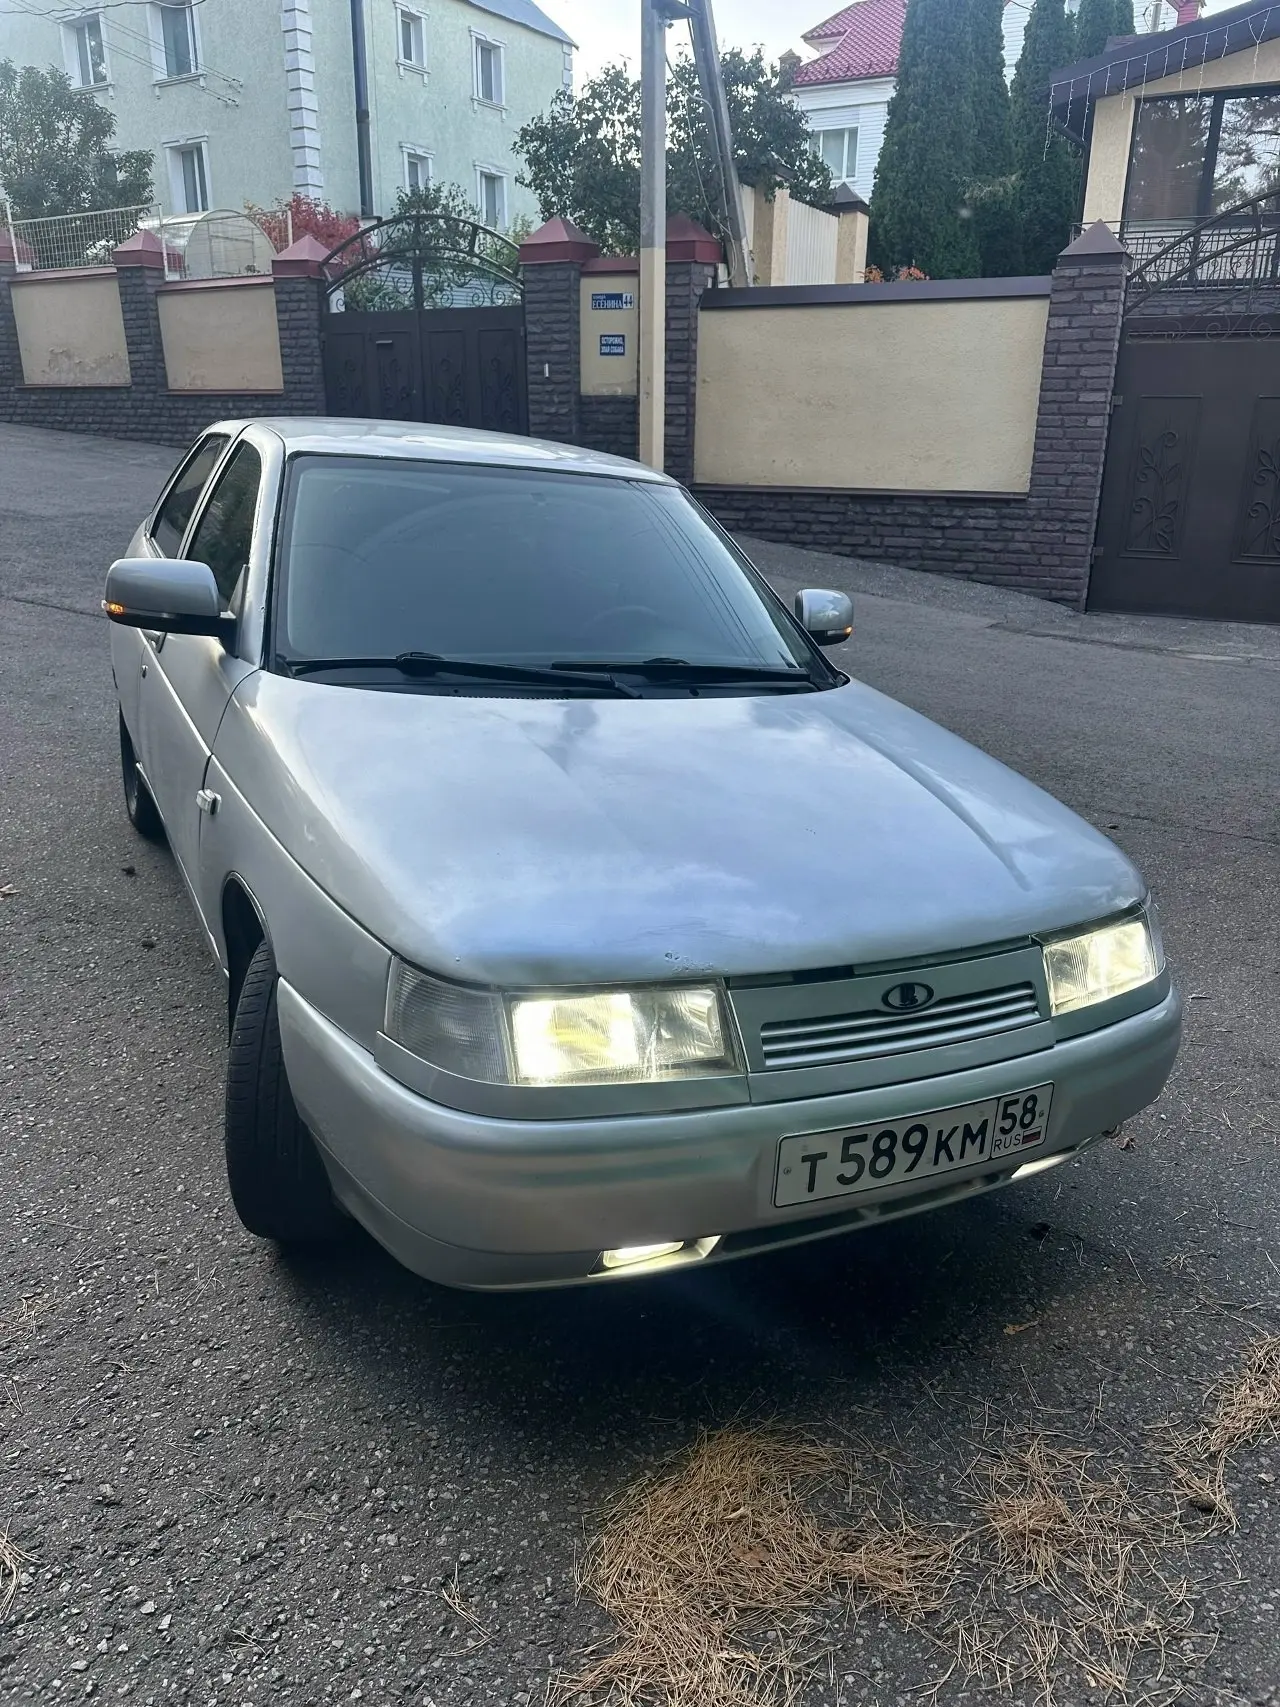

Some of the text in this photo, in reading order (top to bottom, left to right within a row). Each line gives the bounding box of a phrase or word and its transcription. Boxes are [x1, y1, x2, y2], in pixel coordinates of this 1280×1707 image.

[592, 295, 633, 308] ЕСЕНИНА 44
[1000, 1094, 1038, 1135] 58
[993, 1133, 1021, 1152] RUS
